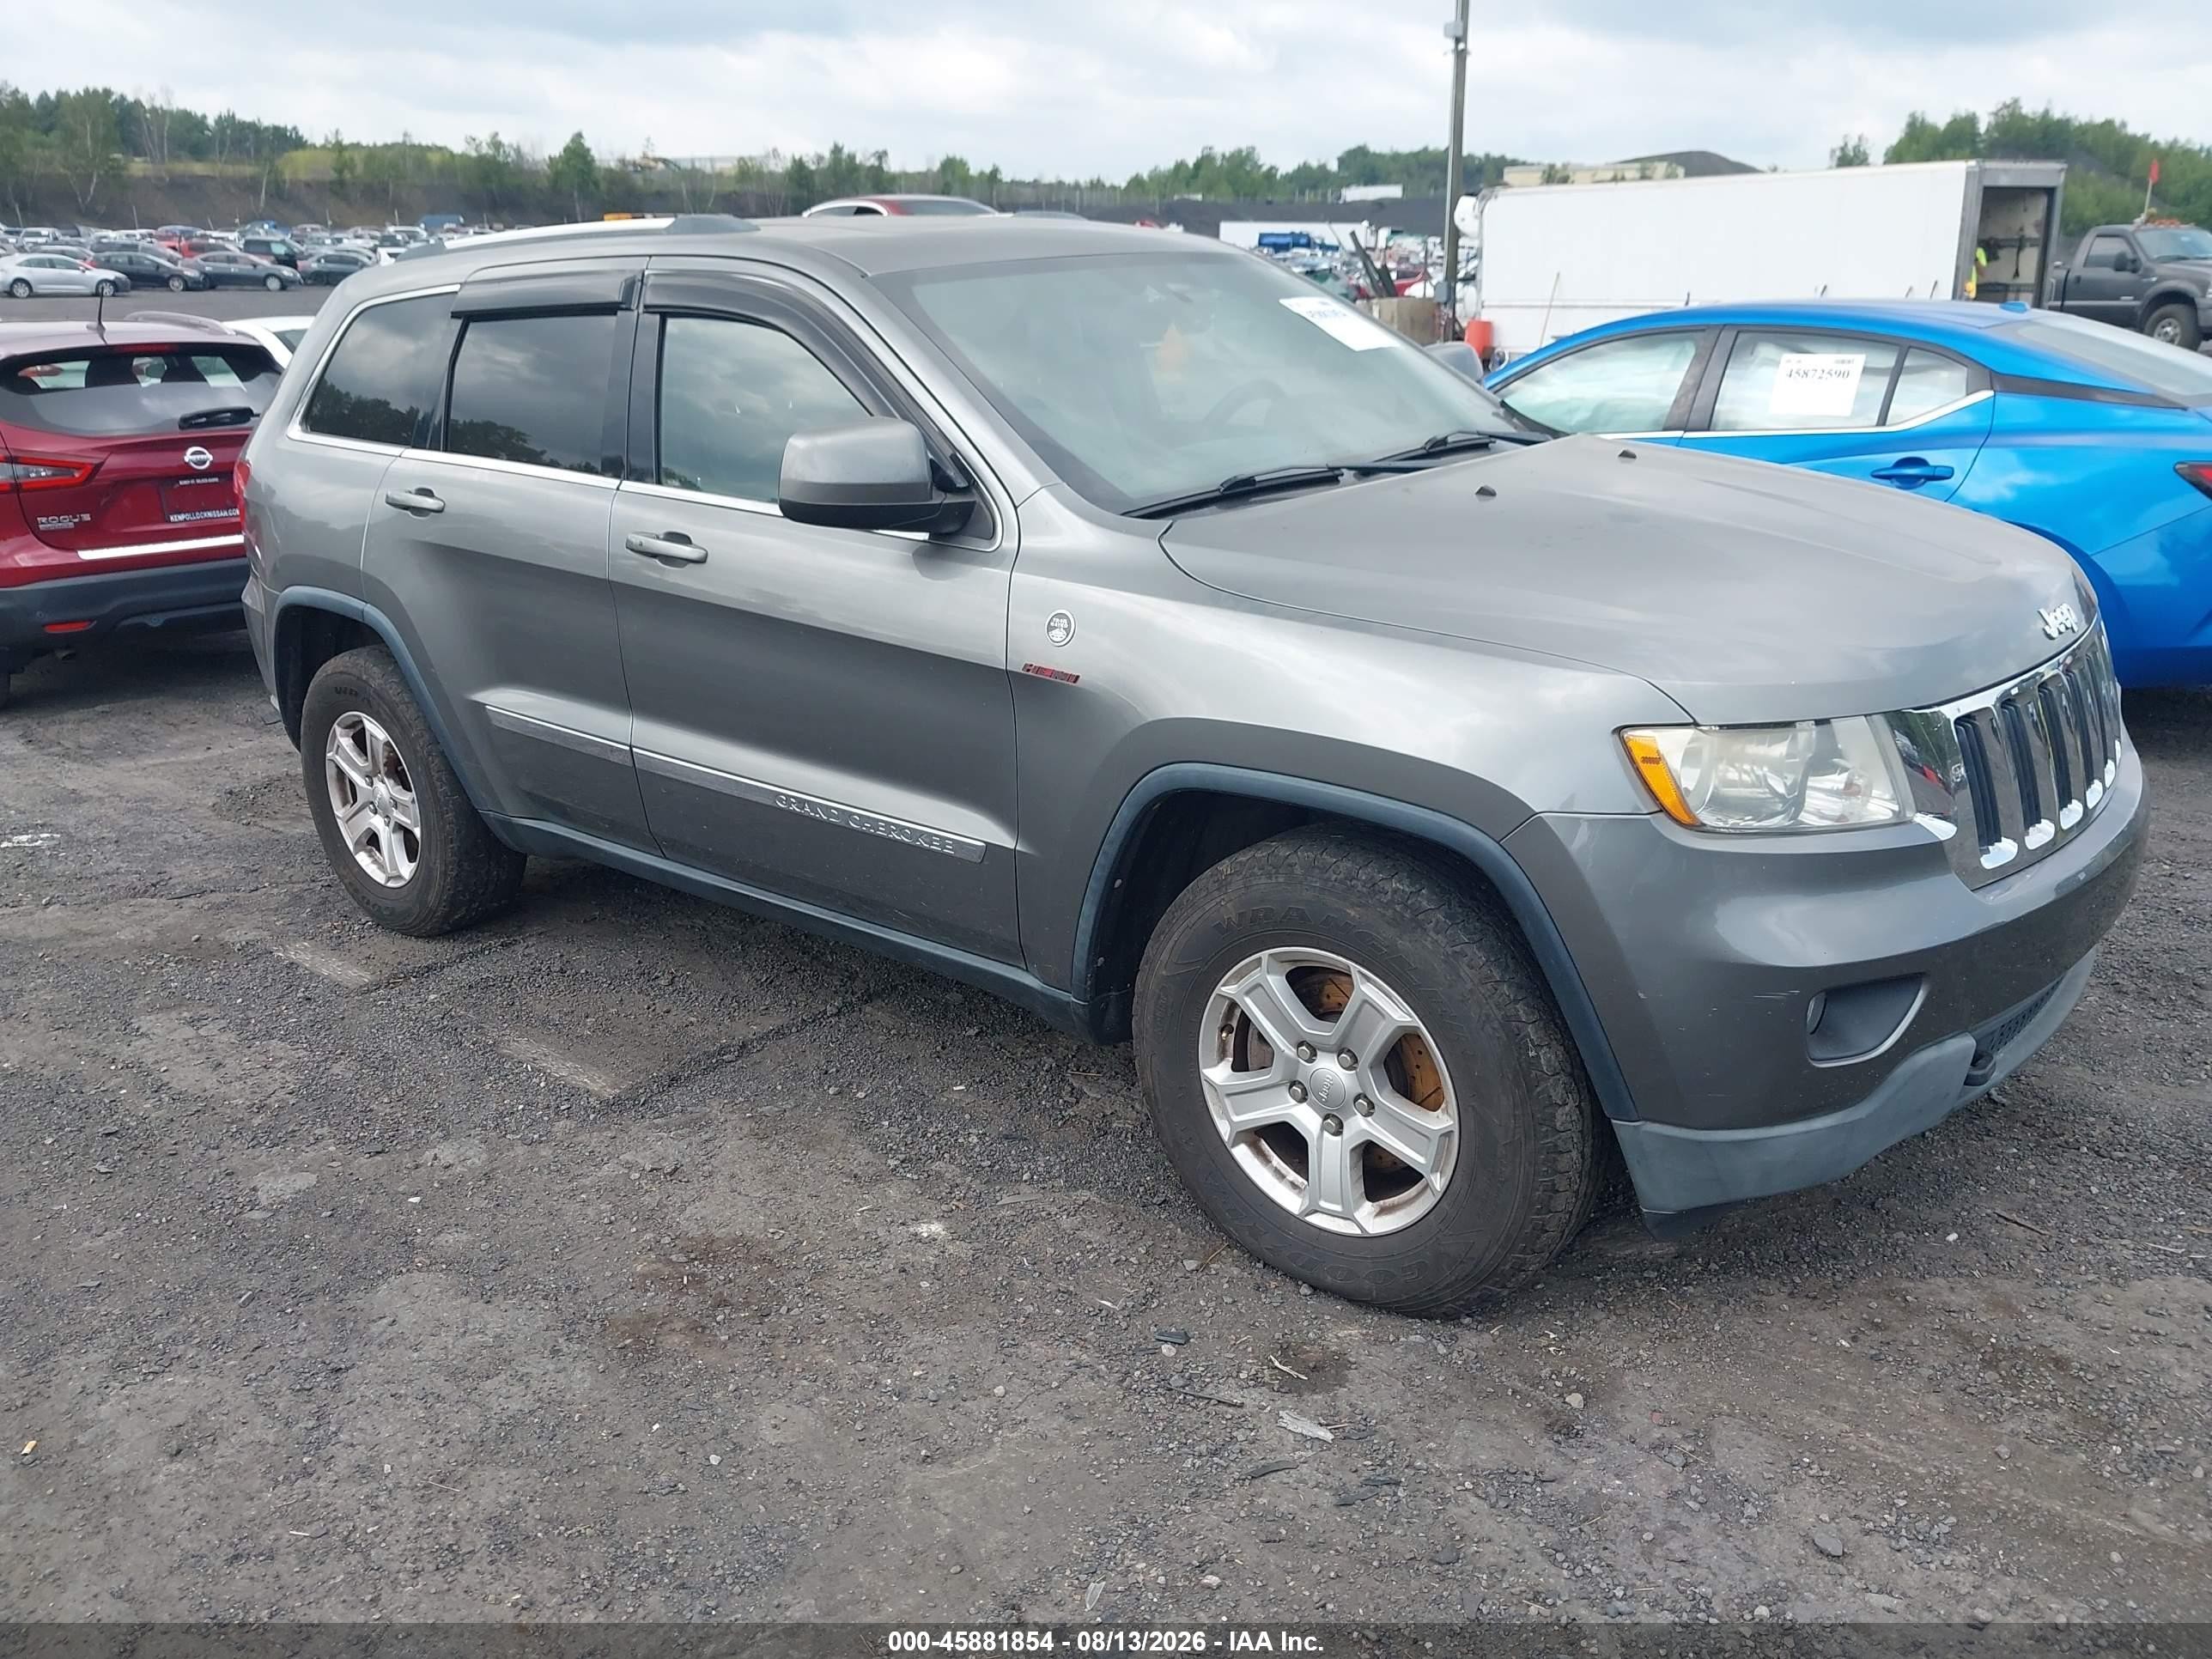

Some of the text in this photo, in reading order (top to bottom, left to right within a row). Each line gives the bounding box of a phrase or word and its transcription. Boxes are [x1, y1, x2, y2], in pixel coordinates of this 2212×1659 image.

[1786, 368, 1850, 380] 45872590
[2037, 603, 2078, 640] Jeep
[775, 794, 955, 854] GRAND CHEROKEE
[1317, 1074, 1334, 1103] Jeep
